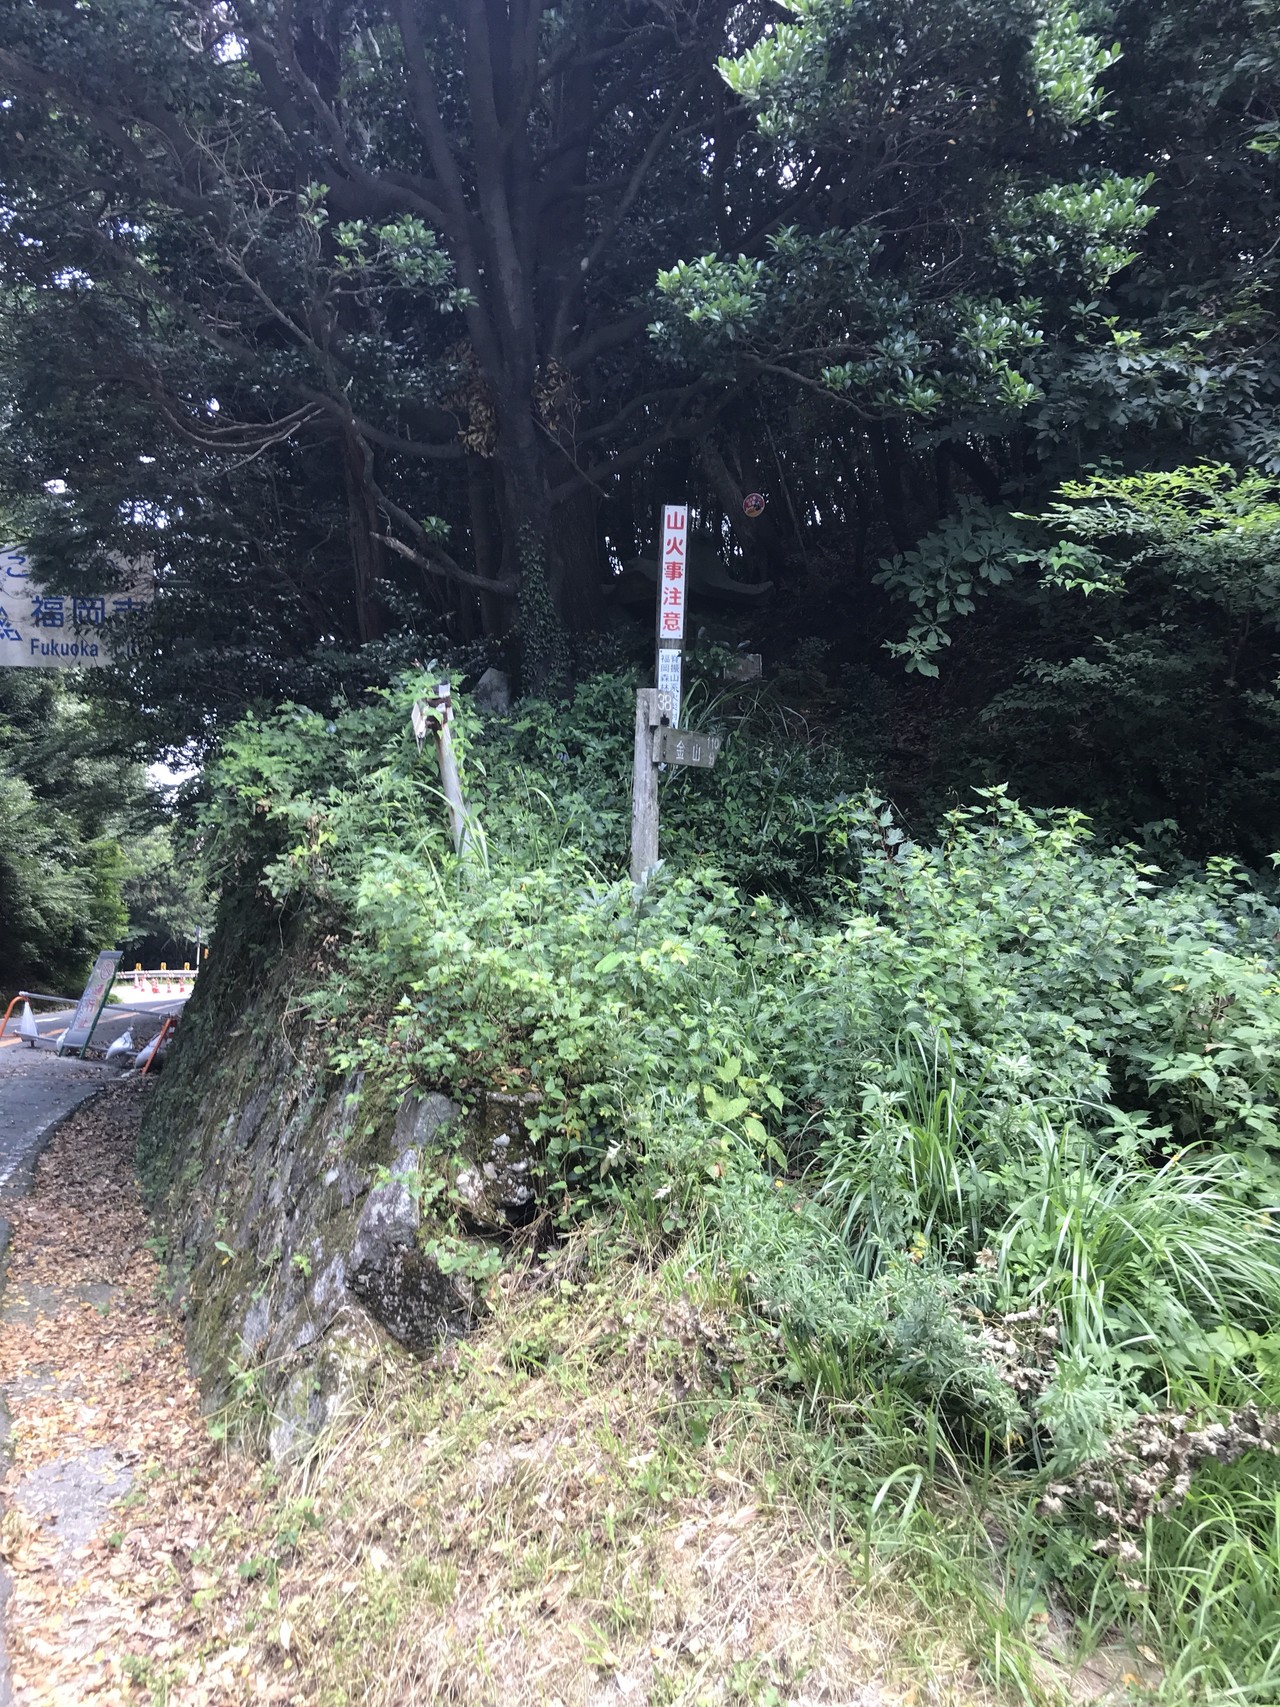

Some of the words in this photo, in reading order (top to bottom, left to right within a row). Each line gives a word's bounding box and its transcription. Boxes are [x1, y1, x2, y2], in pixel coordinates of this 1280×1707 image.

[662, 511, 685, 631] 山火事注意
[30, 638, 99, 657] Fukuoka
[657, 693, 672, 711] 38
[675, 740, 701, 762] 金山
[707, 736, 719, 750] 110
